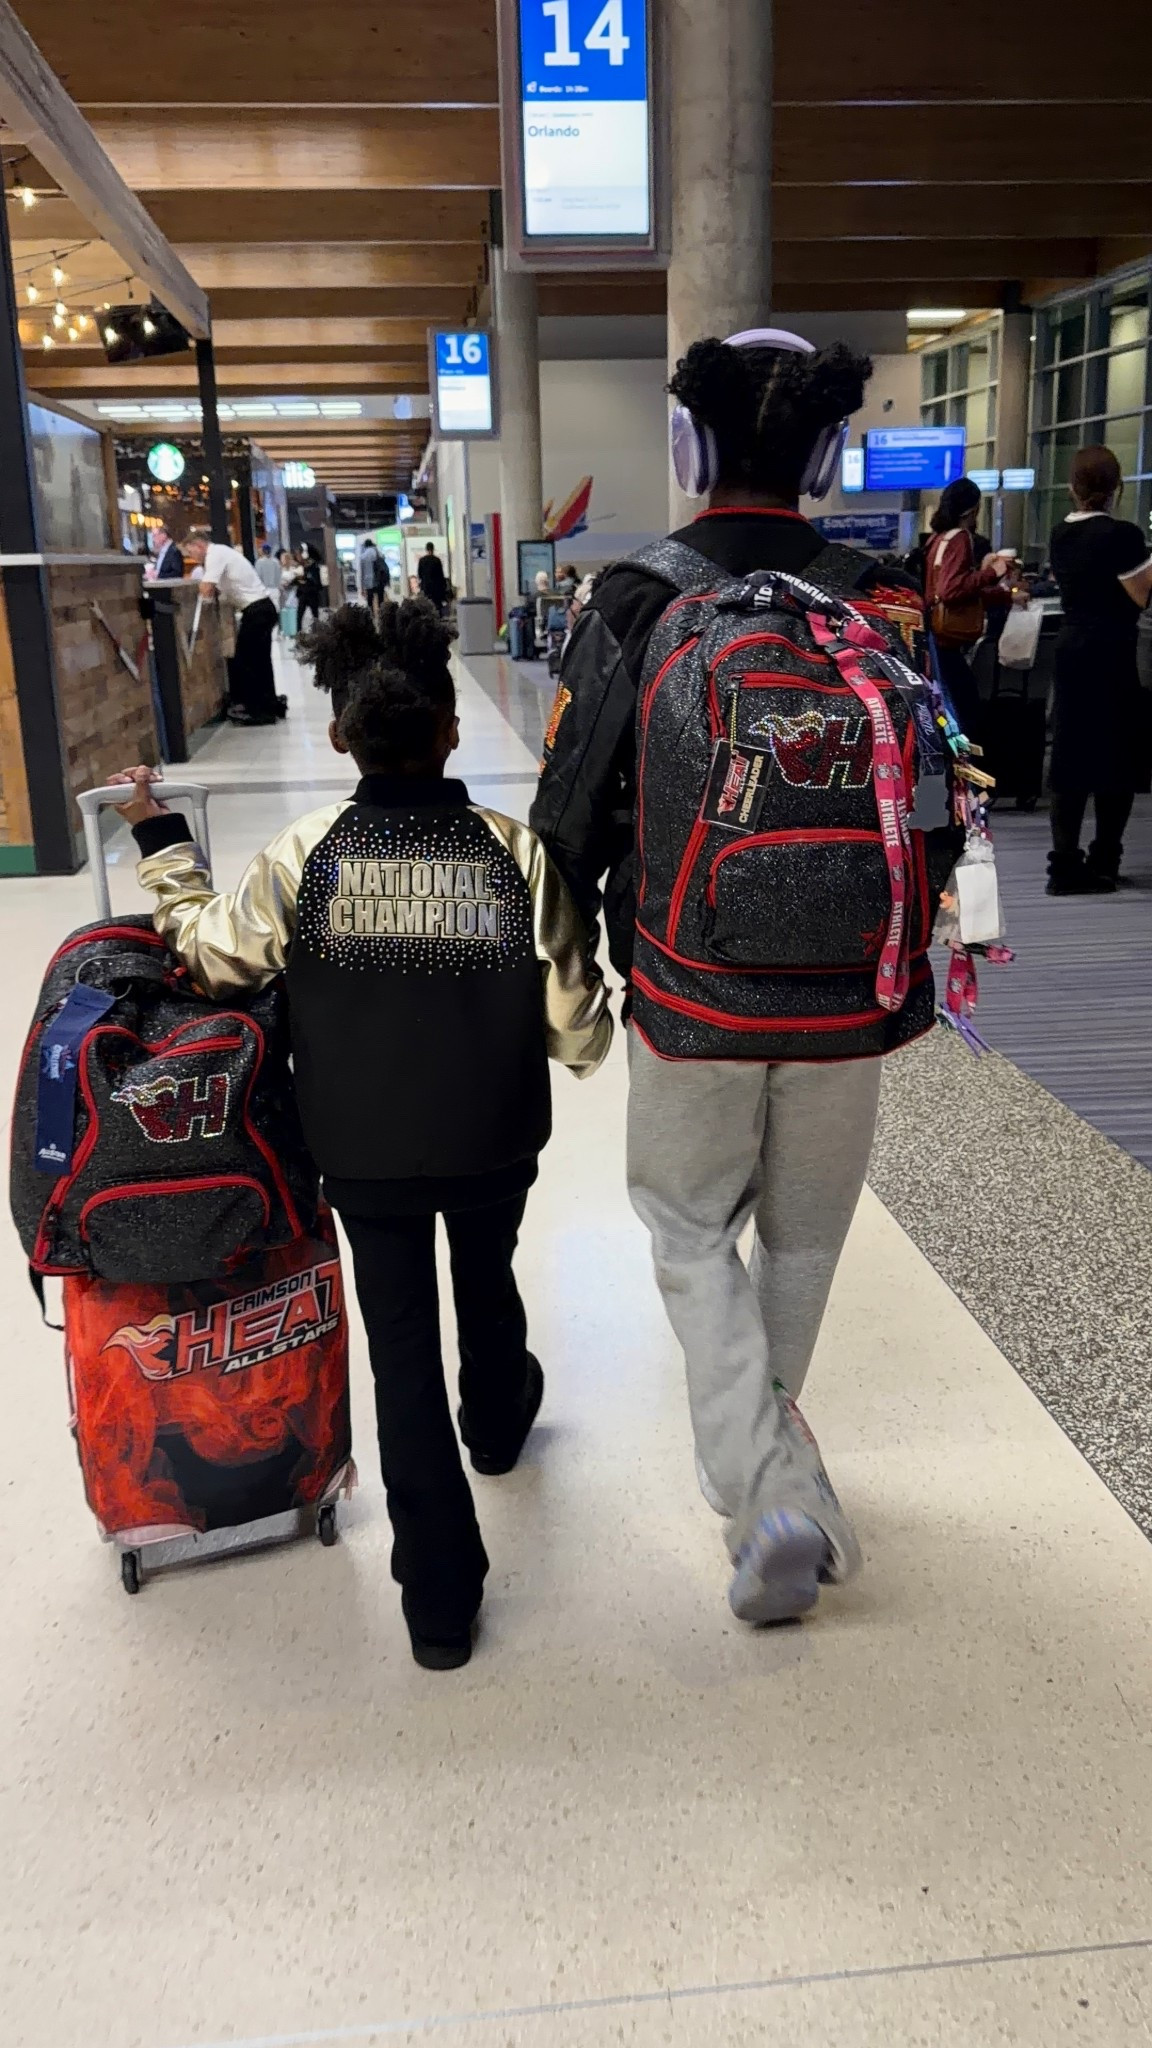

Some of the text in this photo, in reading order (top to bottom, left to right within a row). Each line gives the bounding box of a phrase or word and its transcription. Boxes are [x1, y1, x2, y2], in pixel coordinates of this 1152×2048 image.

[542, 0, 631, 67] 14
[528, 125, 580, 137] Orlando
[445, 334, 482, 364] 16
[874, 434, 888, 446] 16
[866, 697, 888, 745] ATHLETE
[738, 754, 765, 824] CHEERLEADER
[879, 798, 900, 848] ATHLETE
[339, 860, 491, 900] NATIONAL
[331, 897, 498, 938] CHAMPION
[886, 900, 904, 948] ATHLETE
[230, 1271, 312, 1315] CRIMSON
[171, 1259, 342, 1376] HEAT
[224, 1317, 339, 1374] ALLSTARS
